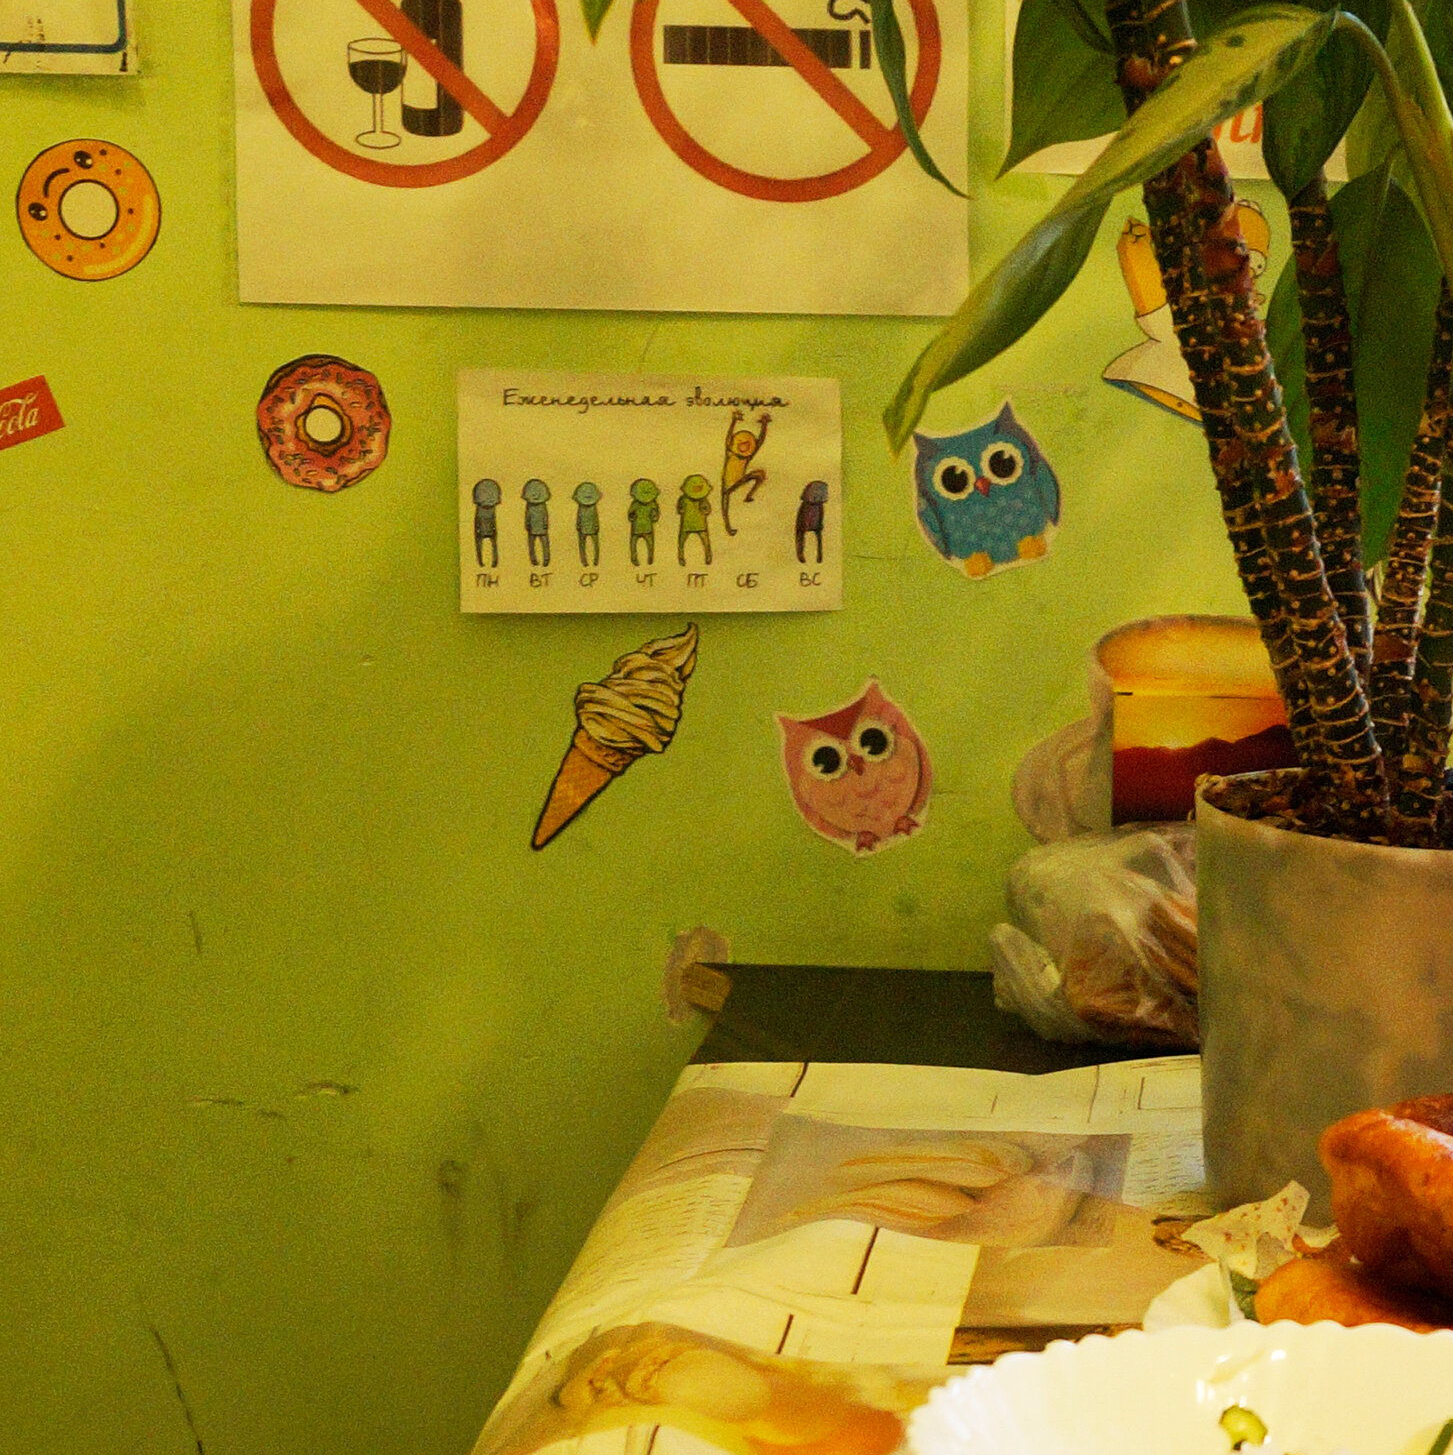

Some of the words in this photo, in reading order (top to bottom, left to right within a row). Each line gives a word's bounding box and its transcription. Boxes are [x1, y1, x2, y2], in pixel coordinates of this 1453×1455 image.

[503, 388, 676, 414] Еженедельная
[529, 573, 553, 588] ВТ
[578, 573, 598, 588] СР
[636, 573, 657, 588] ЧТ
[687, 573, 708, 588] ПТ
[736, 572, 759, 588] СБ
[800, 572, 822, 587] ВС
